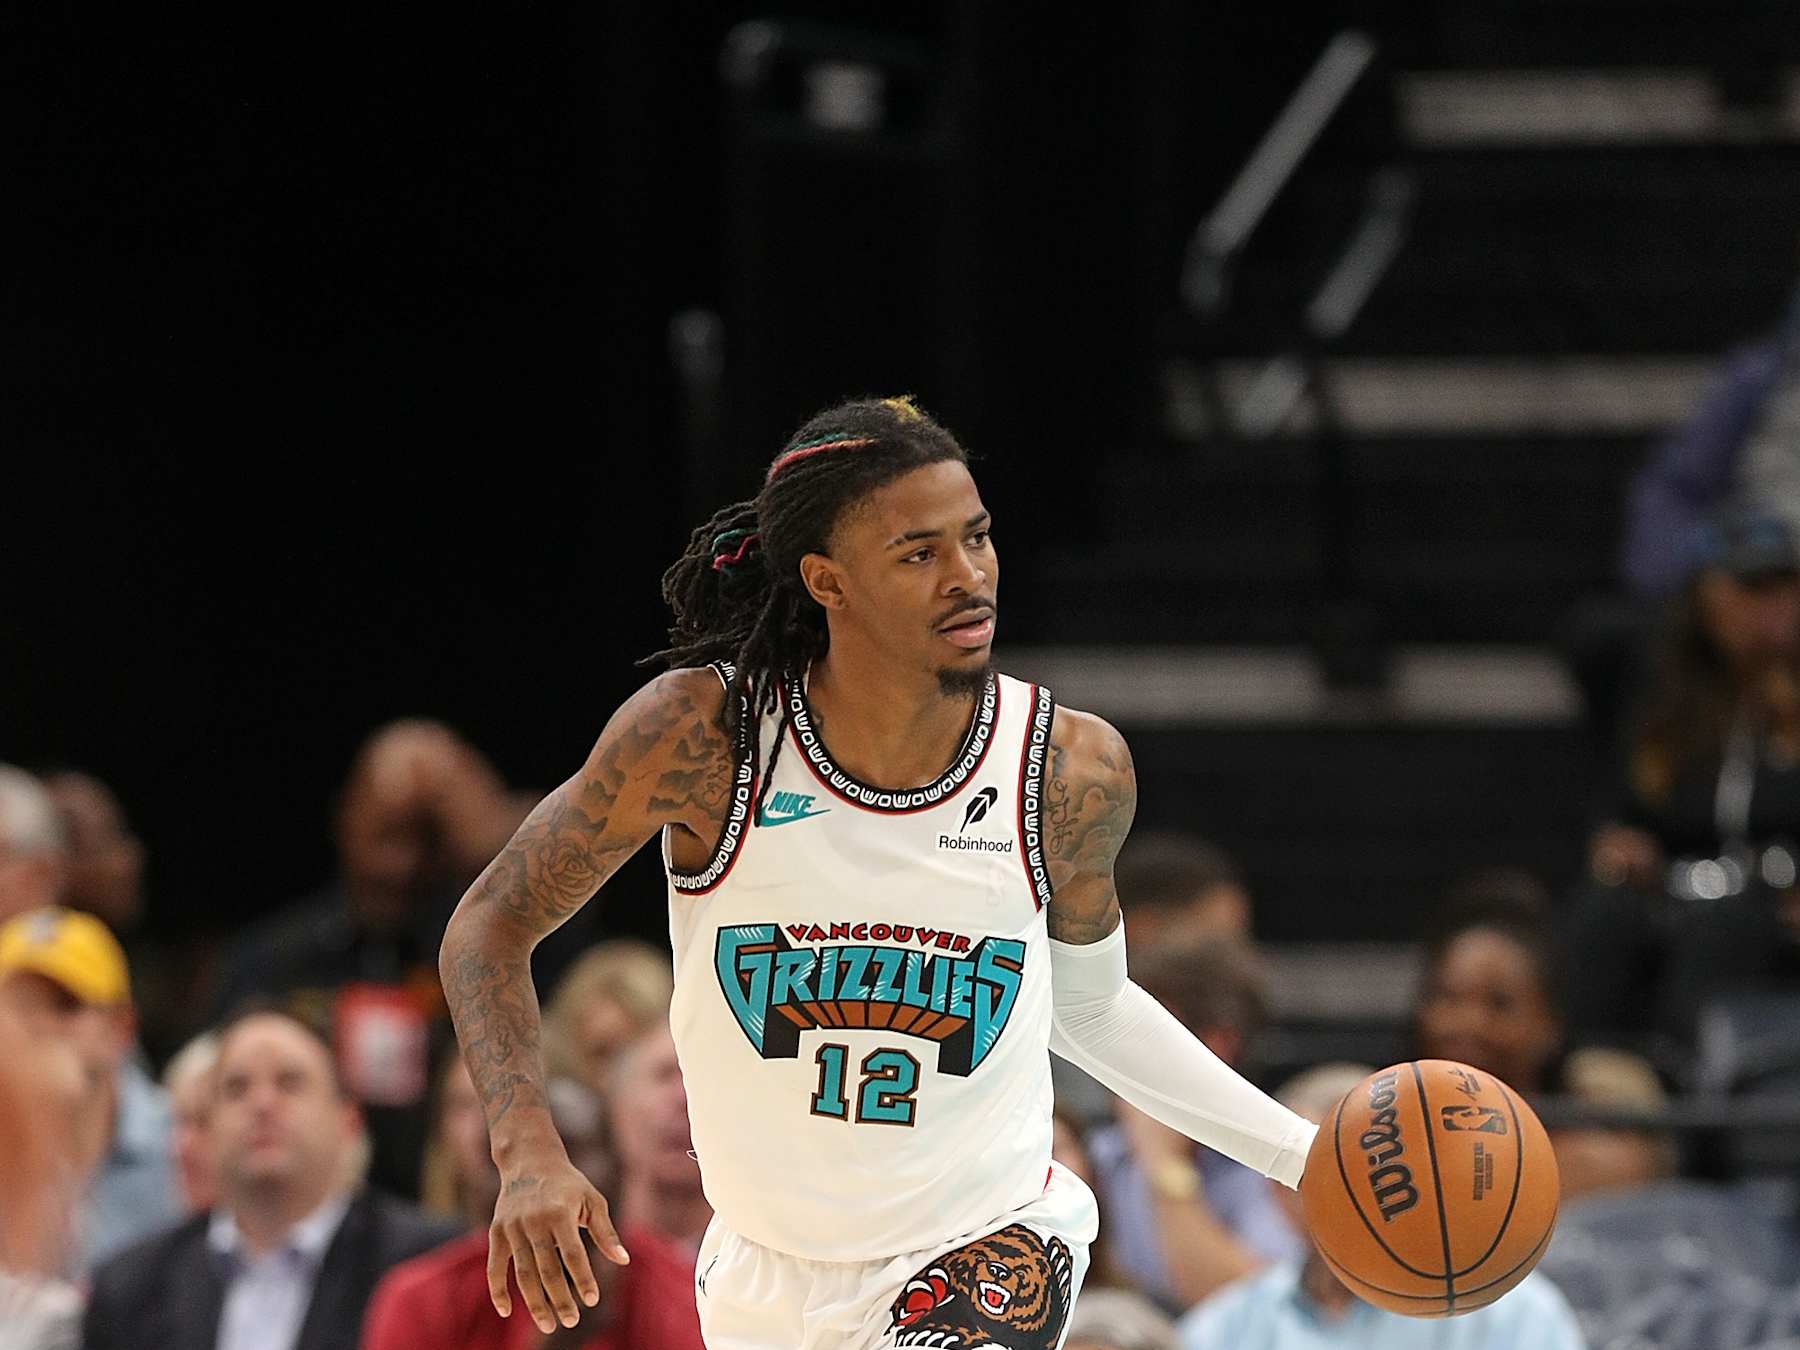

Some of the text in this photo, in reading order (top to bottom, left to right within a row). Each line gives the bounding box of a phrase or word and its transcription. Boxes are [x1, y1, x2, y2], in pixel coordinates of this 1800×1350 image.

[768, 791, 816, 814] NIKE
[938, 836, 1013, 853] Robinhood
[785, 922, 971, 953] VANCOUVER
[714, 923, 1026, 1077] GRIZZLIES
[810, 1043, 921, 1127] 12
[1359, 1070, 1419, 1223] Wilson
